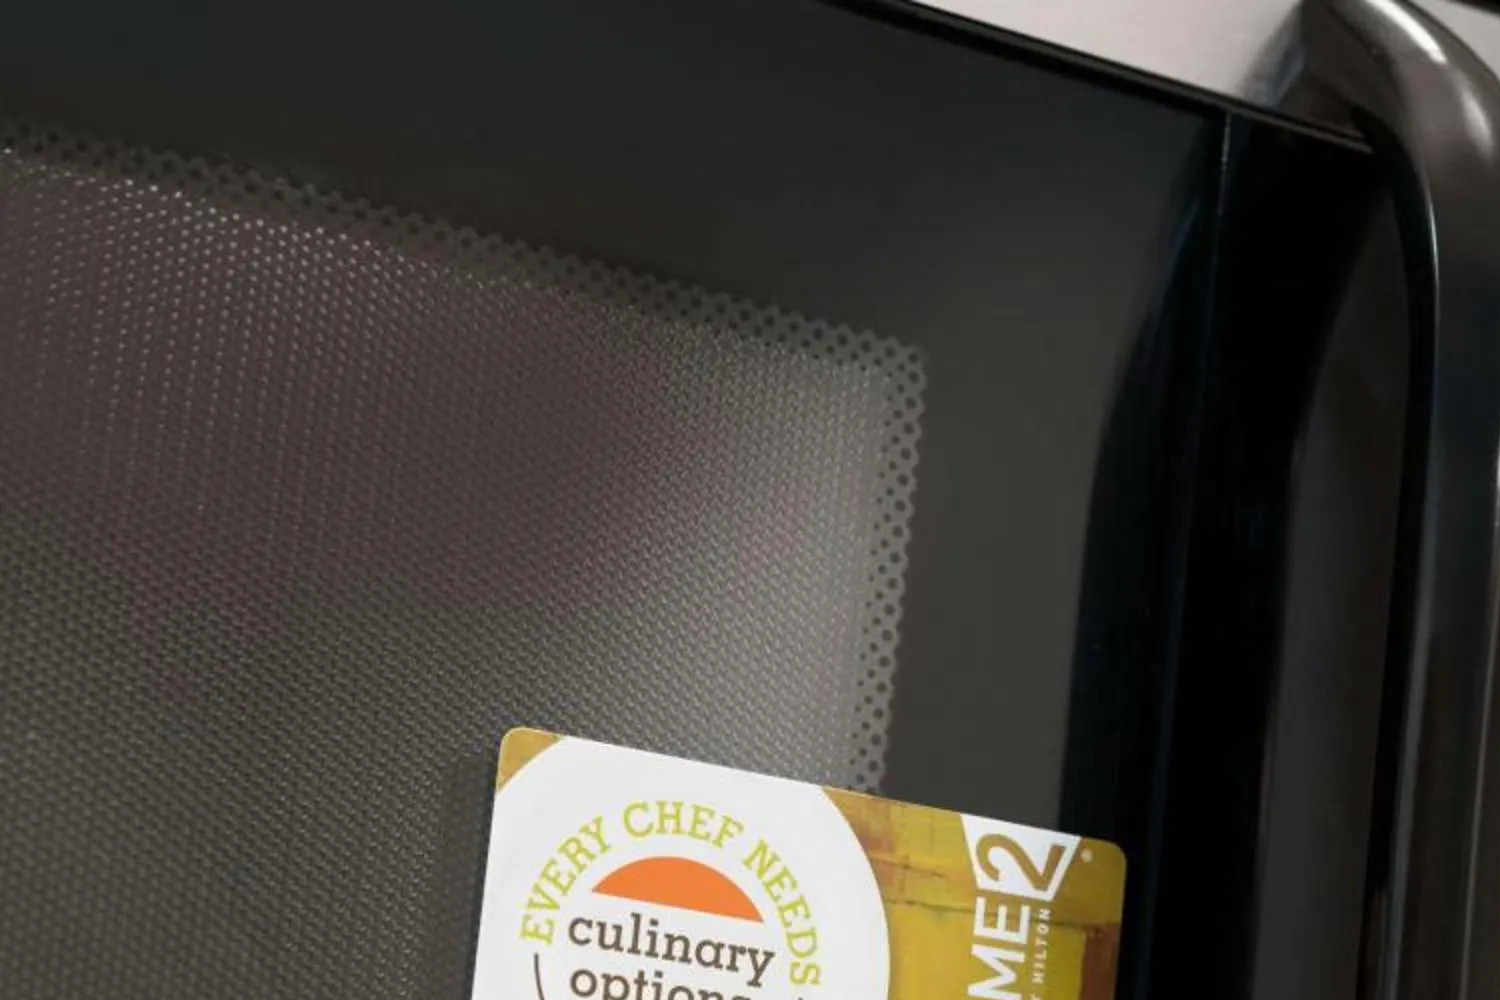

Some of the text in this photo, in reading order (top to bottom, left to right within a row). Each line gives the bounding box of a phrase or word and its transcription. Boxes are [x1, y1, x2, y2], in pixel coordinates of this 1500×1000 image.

[519, 800, 822, 988] EVERY CHEF NEEDS
[567, 912, 775, 989] culinary
[1032, 908, 1051, 984] HILTON
